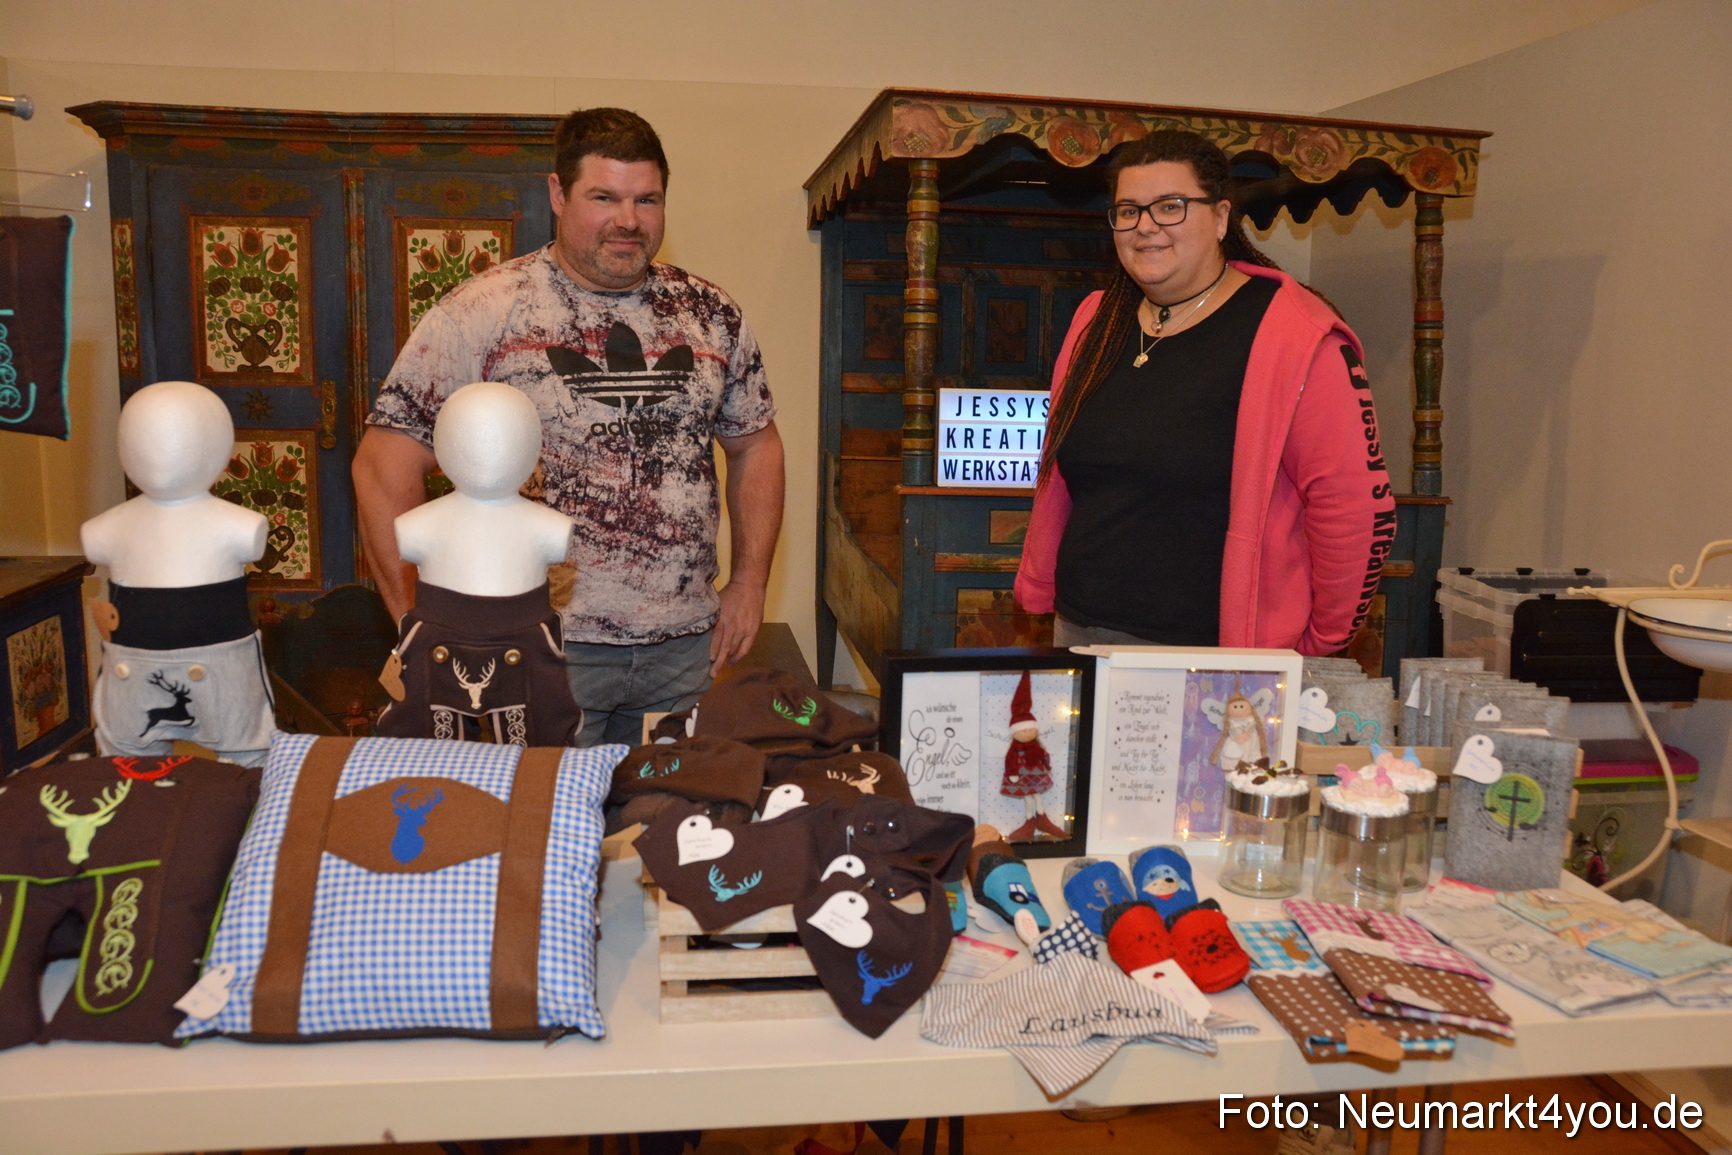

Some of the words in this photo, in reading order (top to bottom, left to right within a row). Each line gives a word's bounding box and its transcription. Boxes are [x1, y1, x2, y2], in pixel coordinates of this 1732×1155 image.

[955, 396, 1050, 418] JESSYS
[590, 417, 676, 437] adidas
[946, 427, 1041, 449] KREATI
[943, 459, 1041, 481] WERKSTAT
[1018, 1000, 1162, 1035] Lausbua
